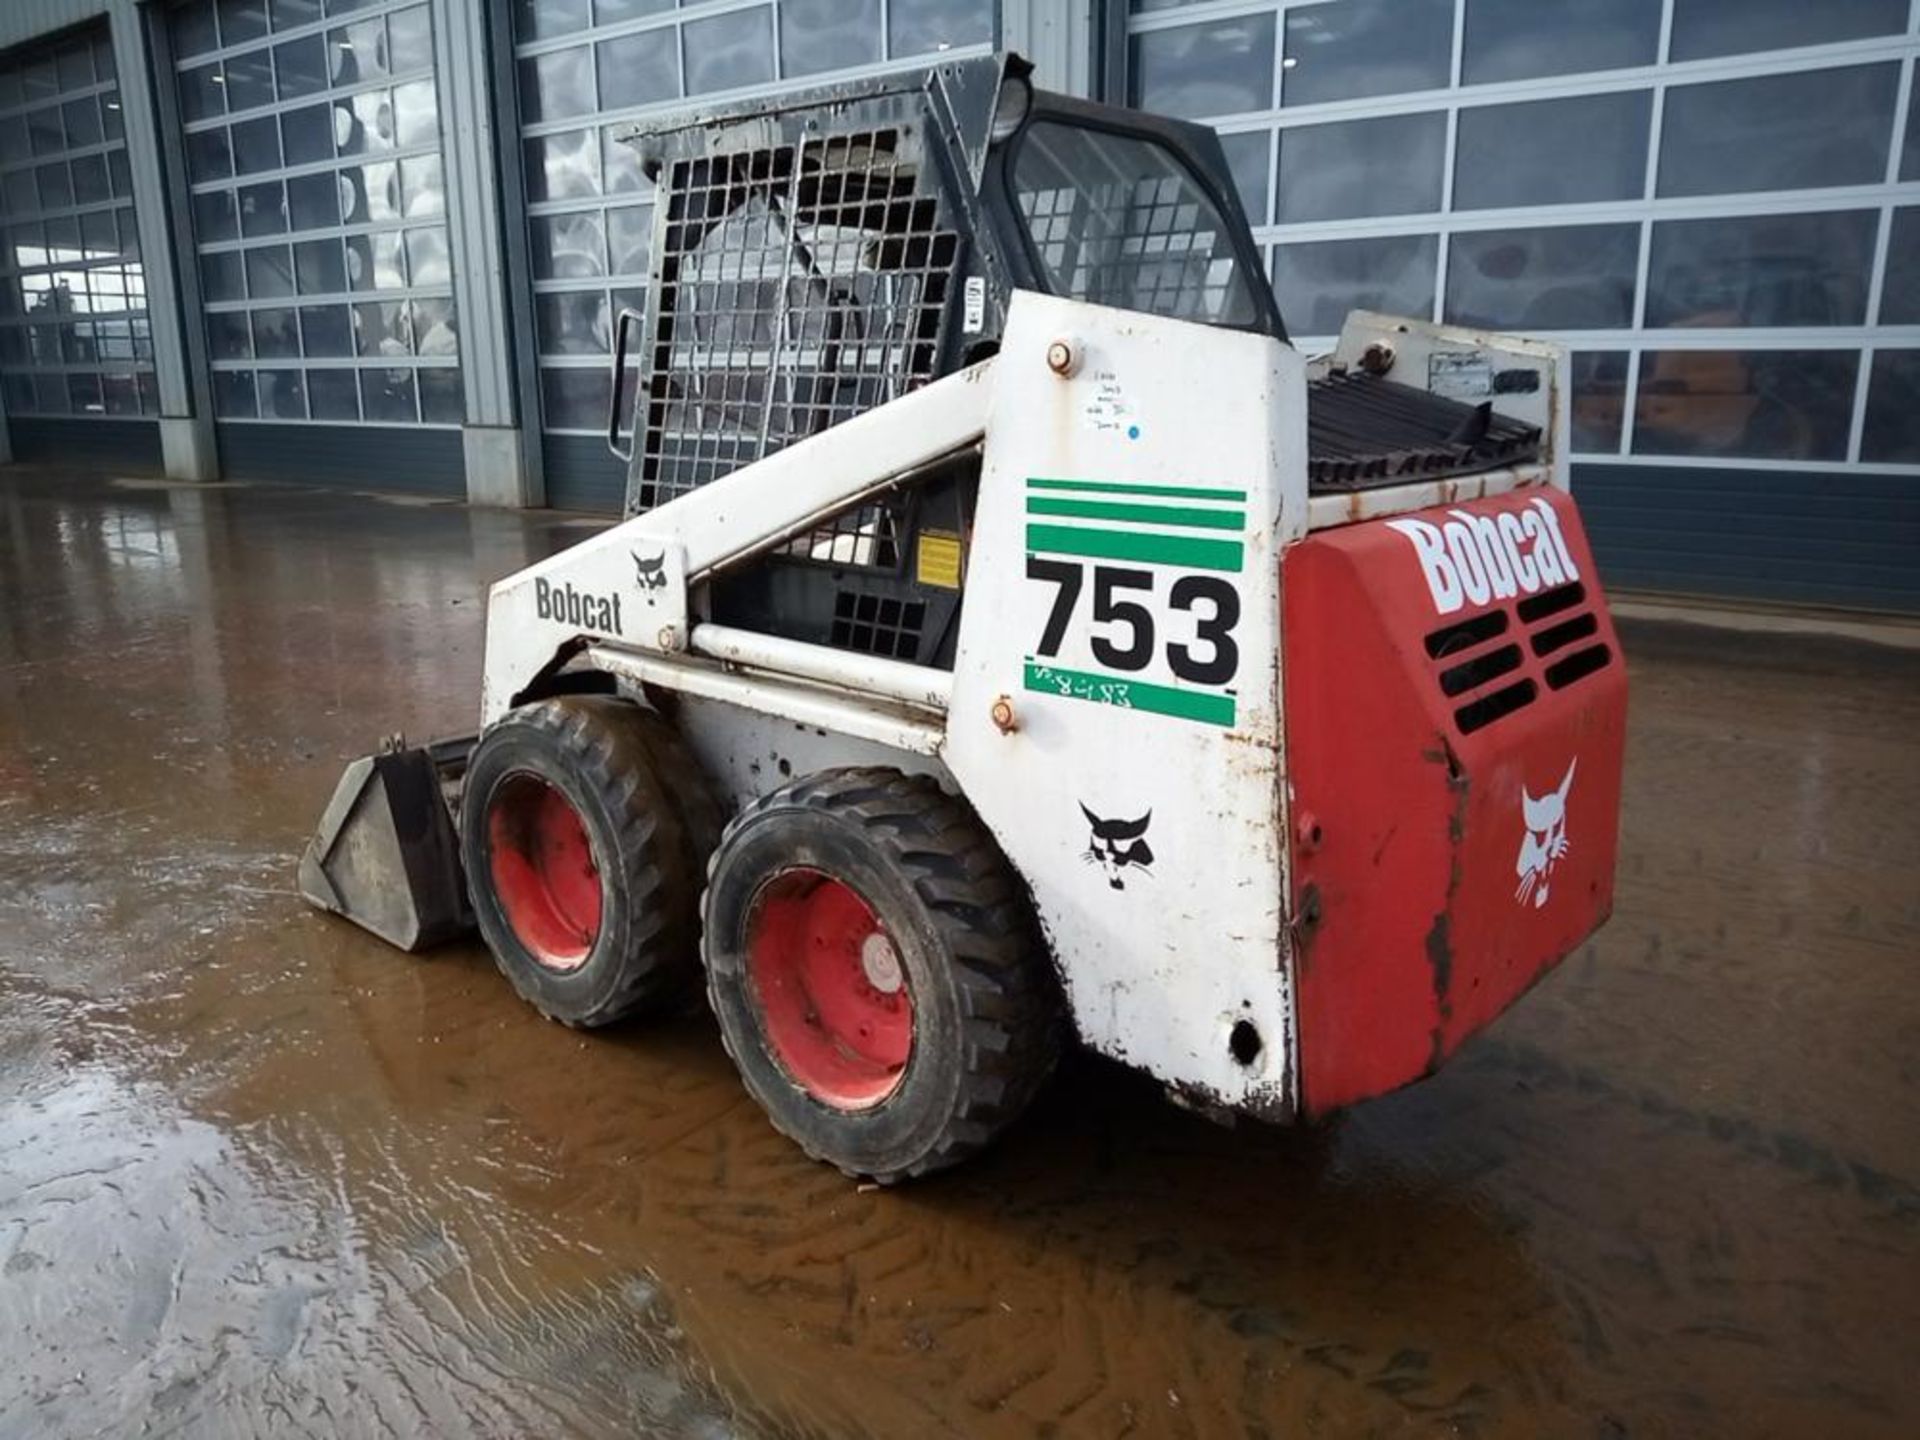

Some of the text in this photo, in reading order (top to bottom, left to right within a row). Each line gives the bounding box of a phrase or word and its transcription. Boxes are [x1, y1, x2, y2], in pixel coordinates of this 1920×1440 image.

[535, 577, 622, 635] Bobcat
[1385, 497, 1579, 615] Bobcat
[1026, 558, 1240, 686] 753
